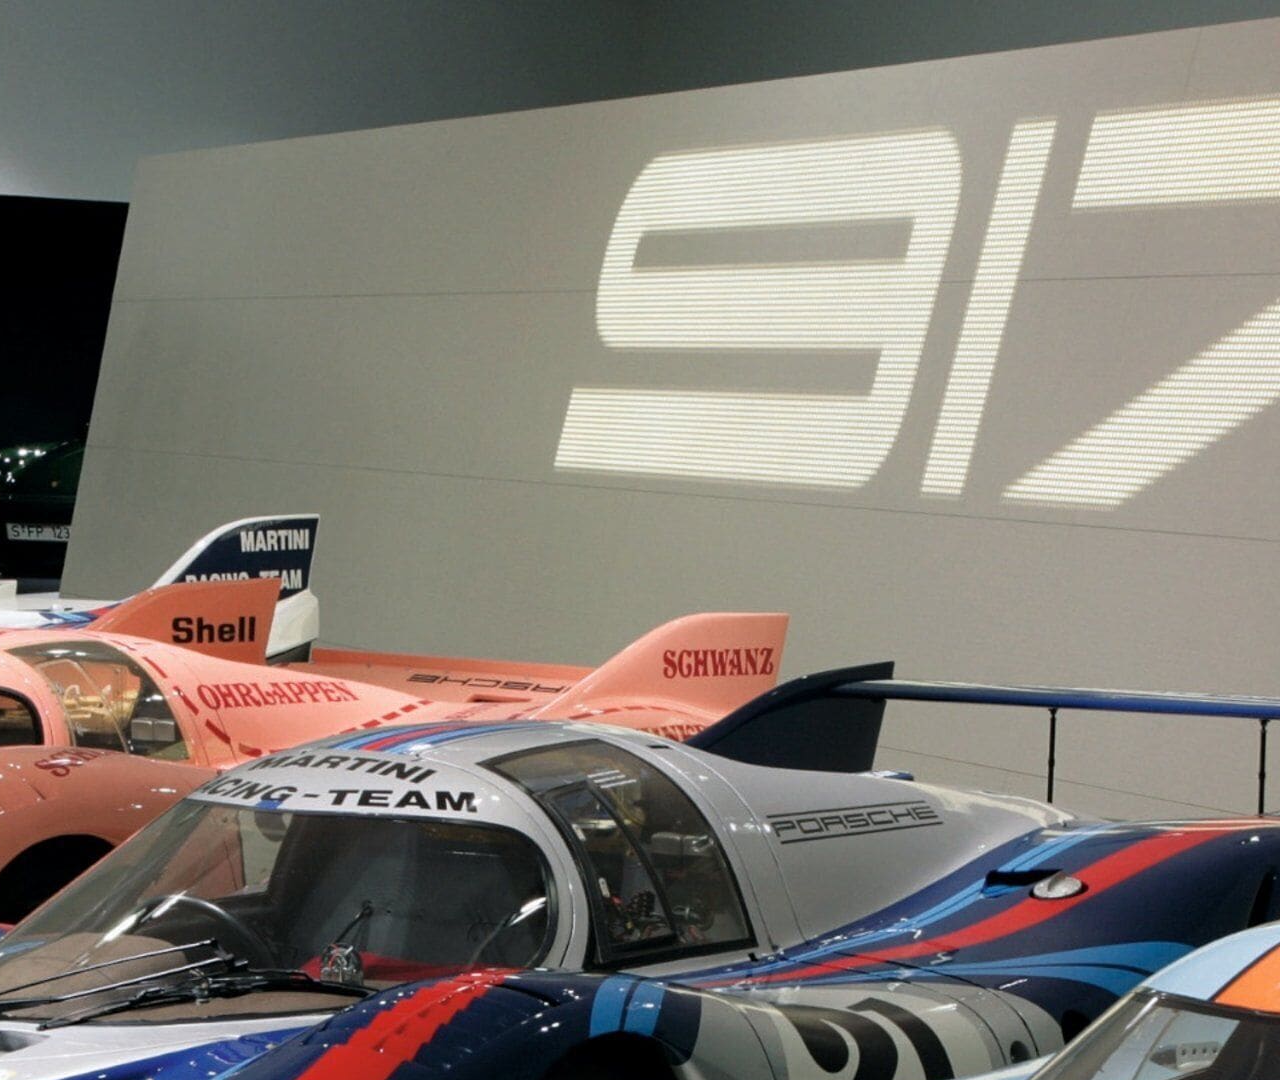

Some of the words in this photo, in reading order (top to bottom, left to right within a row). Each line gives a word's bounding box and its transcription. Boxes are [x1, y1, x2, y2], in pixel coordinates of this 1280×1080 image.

[240, 529, 310, 552] MARTINI
[172, 616, 256, 643] Shell
[663, 648, 774, 679] SCHWANZ
[197, 681, 359, 710] OHRLAPPEN
[249, 754, 437, 784] MARTINI
[771, 805, 939, 837] PORSCHE
